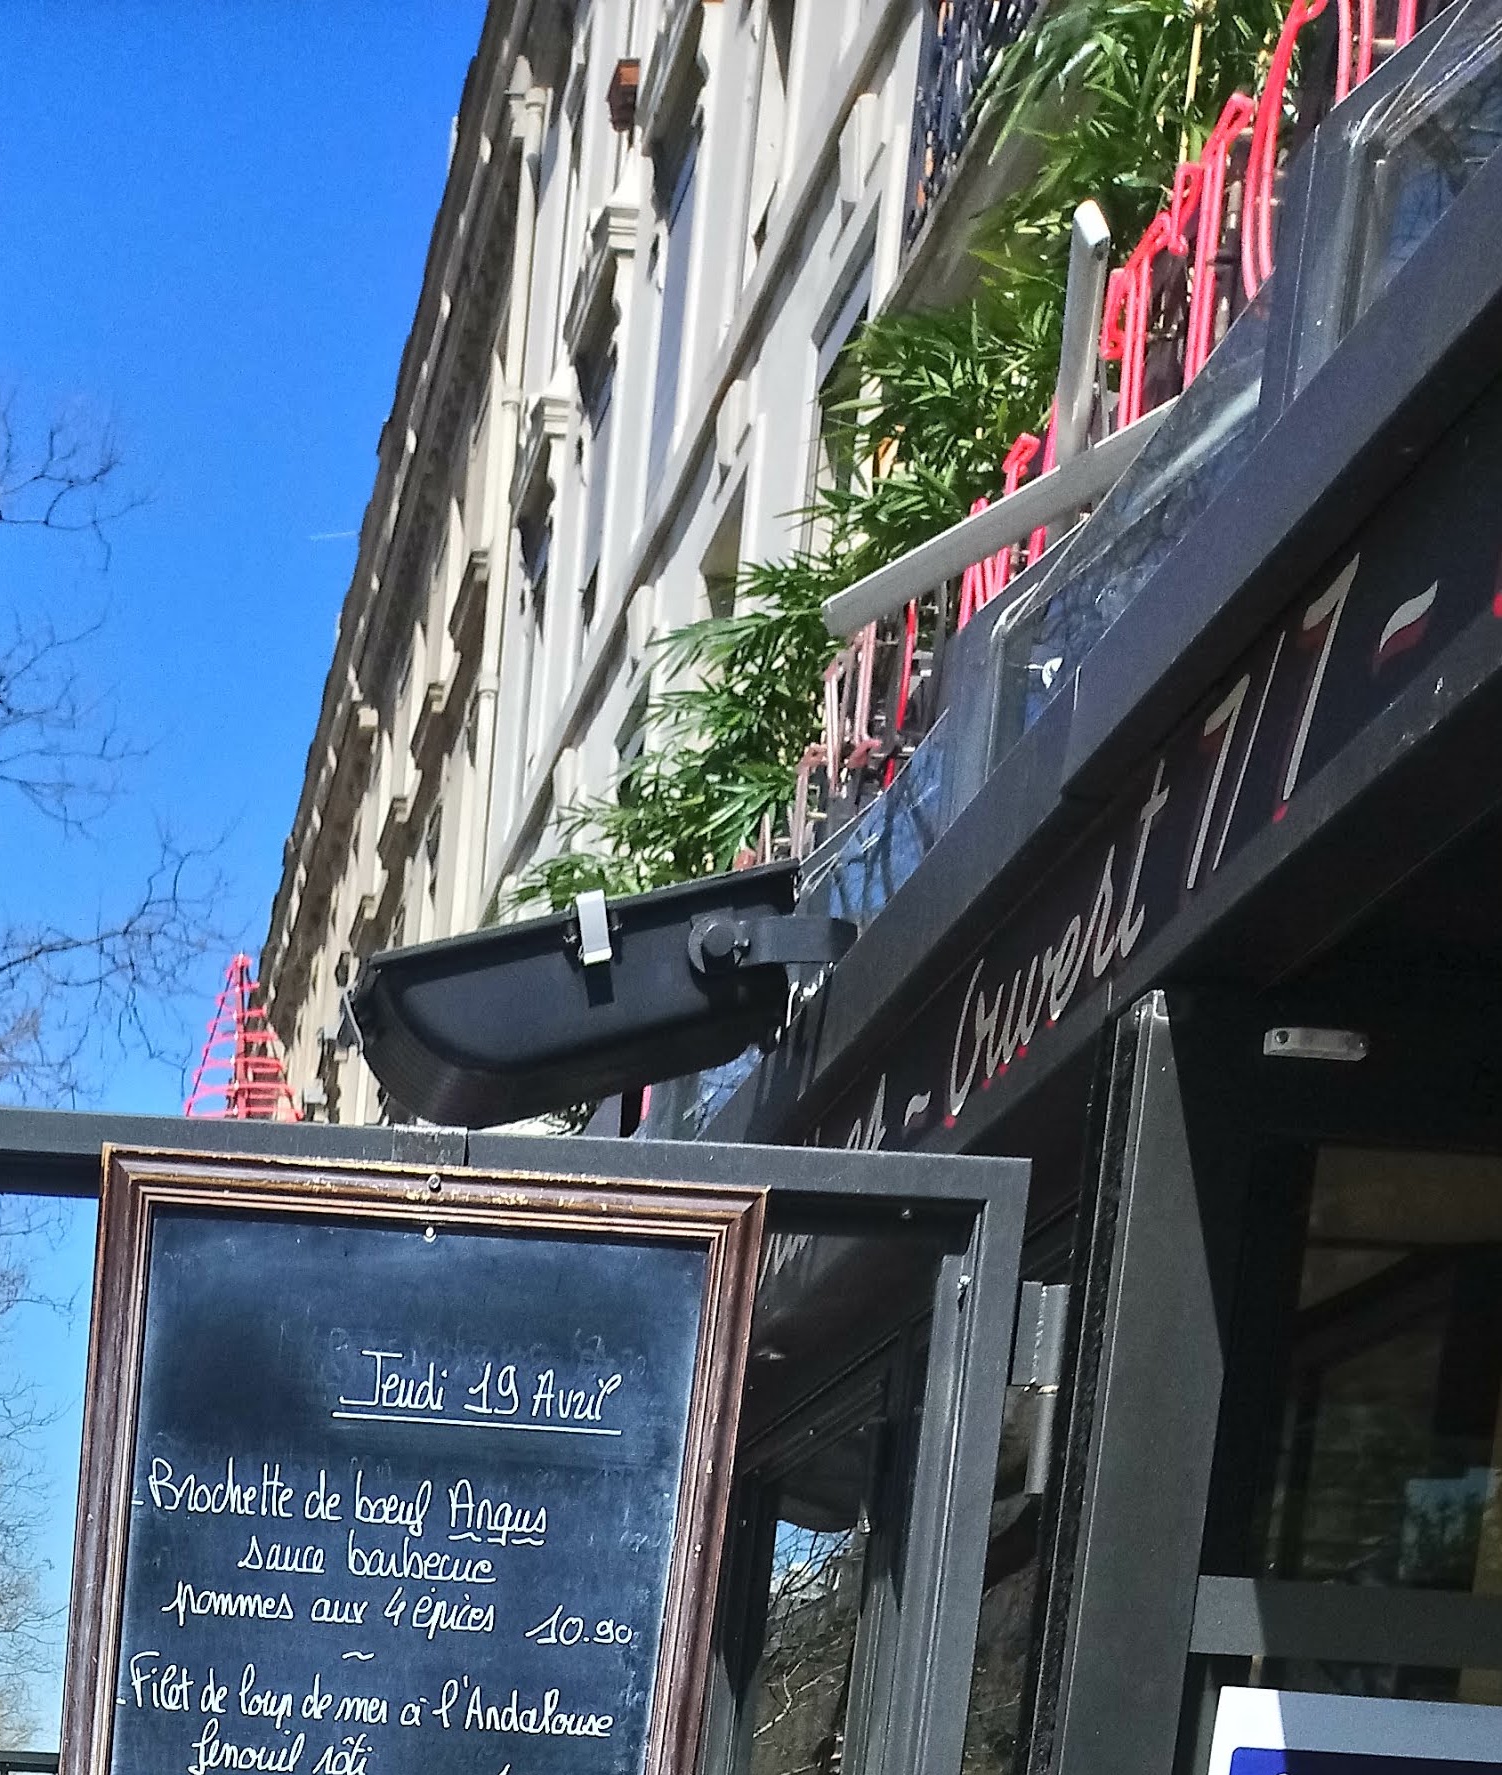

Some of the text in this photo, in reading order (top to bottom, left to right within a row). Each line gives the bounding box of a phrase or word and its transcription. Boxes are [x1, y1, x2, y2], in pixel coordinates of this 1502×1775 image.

[339, 1349, 622, 1421] Jeudi 19 Avril
[304, 1469, 342, 1521] de
[448, 1478, 548, 1544] Angus
[237, 1529, 496, 1583] sauce barbecue
[161, 1580, 294, 1627] pommes
[310, 1596, 364, 1626] aux
[383, 1586, 407, 1627] 4
[524, 1604, 633, 1646] 10.90
[200, 1667, 227, 1714] de
[238, 1662, 293, 1730] loup
[300, 1672, 334, 1720] de
[333, 1696, 388, 1725] mer
[187, 1717, 305, 1775] fenouil
